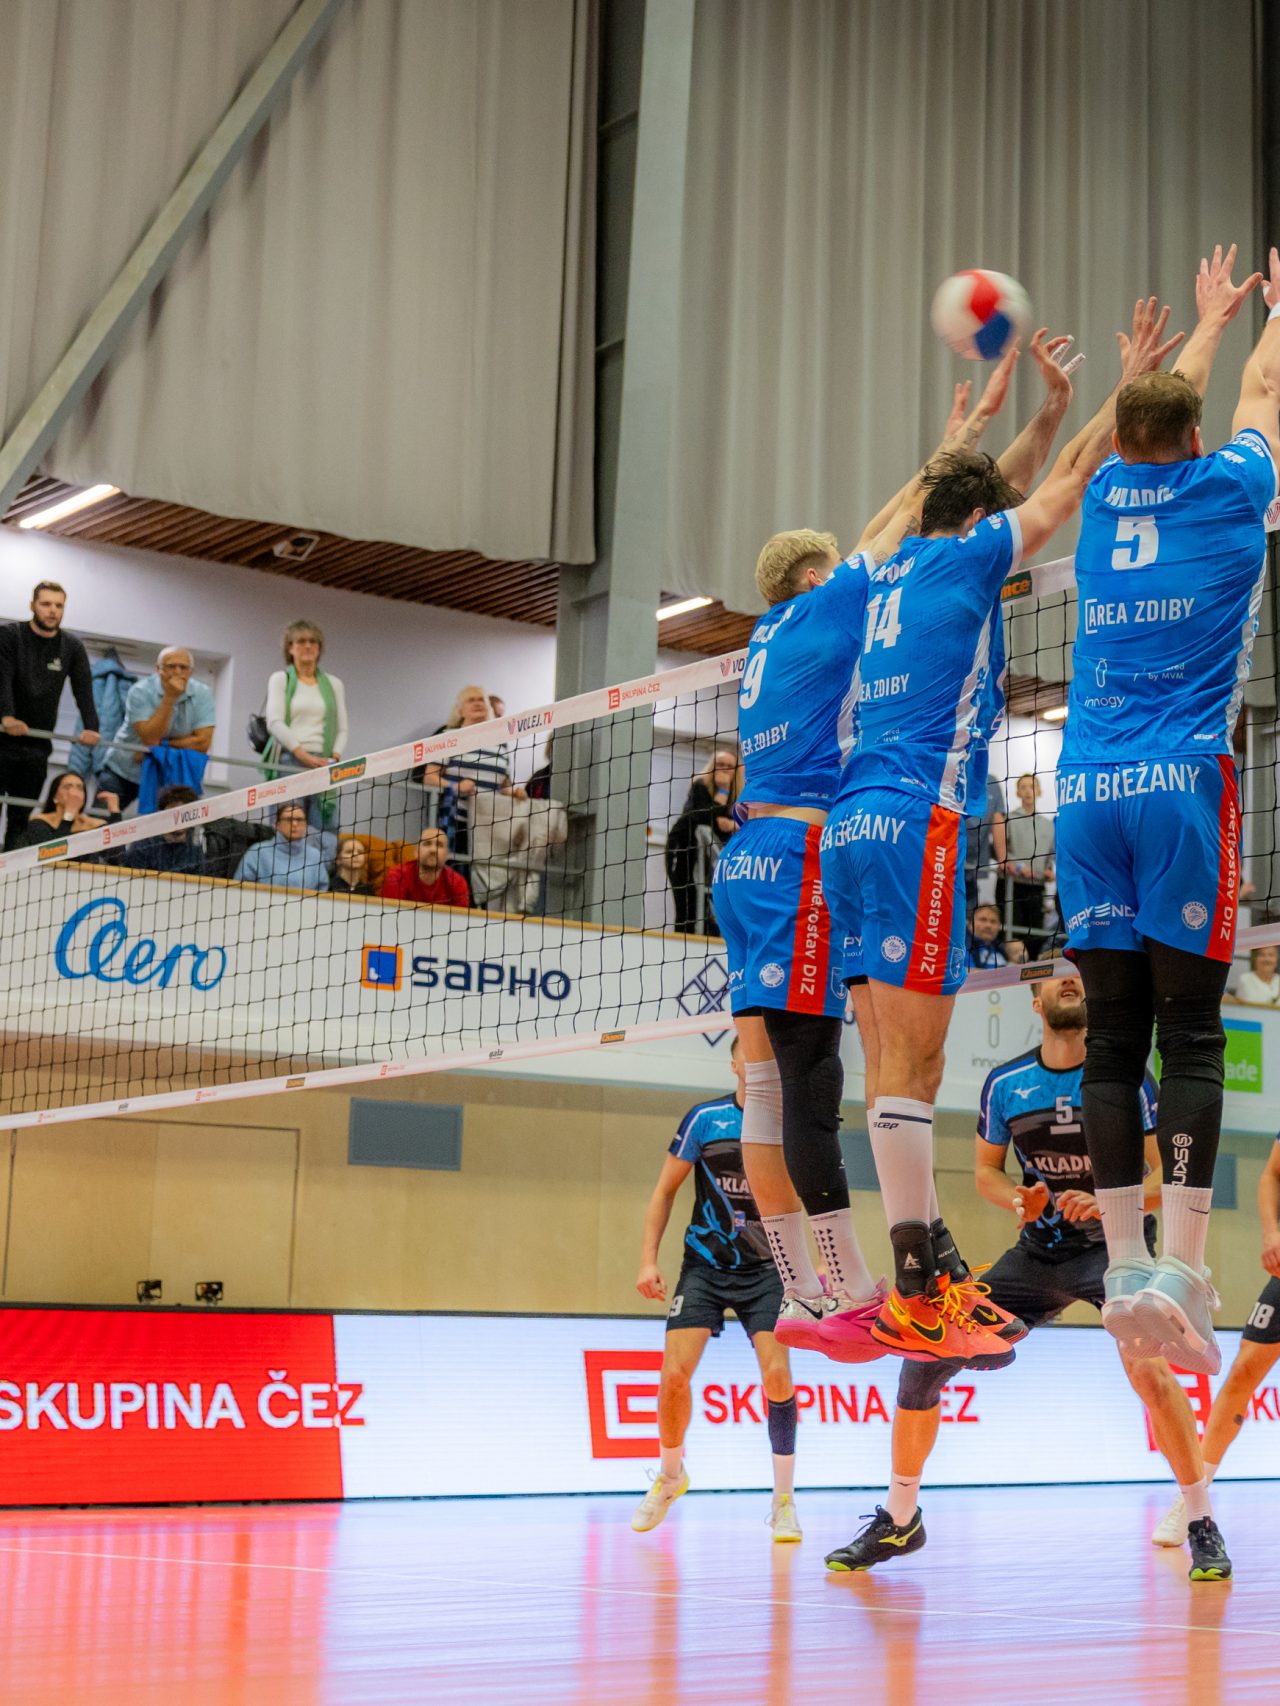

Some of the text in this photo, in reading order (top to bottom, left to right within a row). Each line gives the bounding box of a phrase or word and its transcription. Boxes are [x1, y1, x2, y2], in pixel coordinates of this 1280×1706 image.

[1111, 514, 1160, 571] 5
[1001, 579, 1030, 599] nce
[863, 586, 904, 655] 14
[1089, 597, 1195, 627] AREA ZDIBY
[621, 682, 661, 701] SKUPINA ČEZ
[739, 648, 768, 710] 9
[860, 672, 910, 703] EA ZDIBY
[1161, 672, 1184, 680] MVM
[1084, 696, 1126, 708] innogy
[517, 710, 554, 733] VOLEJ.TV
[741, 720, 790, 758] EA ZDIBY
[1095, 761, 1201, 802] BŘEŽANY
[920, 846, 946, 976] metrostav DIZ
[1220, 907, 1233, 941] DIZ
[799, 879, 823, 996] metrostav DIZ
[877, 1121, 899, 1130] cep
[1055, 1095, 1073, 1125] 5
[1034, 1155, 1092, 1173] KLADN
[1172, 1147, 1189, 1188] SKIN
[722, 1177, 750, 1194] KLA
[1247, 1302, 1275, 1329] 18
[0, 1369, 366, 1430] SKUPINA ČEZ
[939, 1385, 980, 1423] EZ
